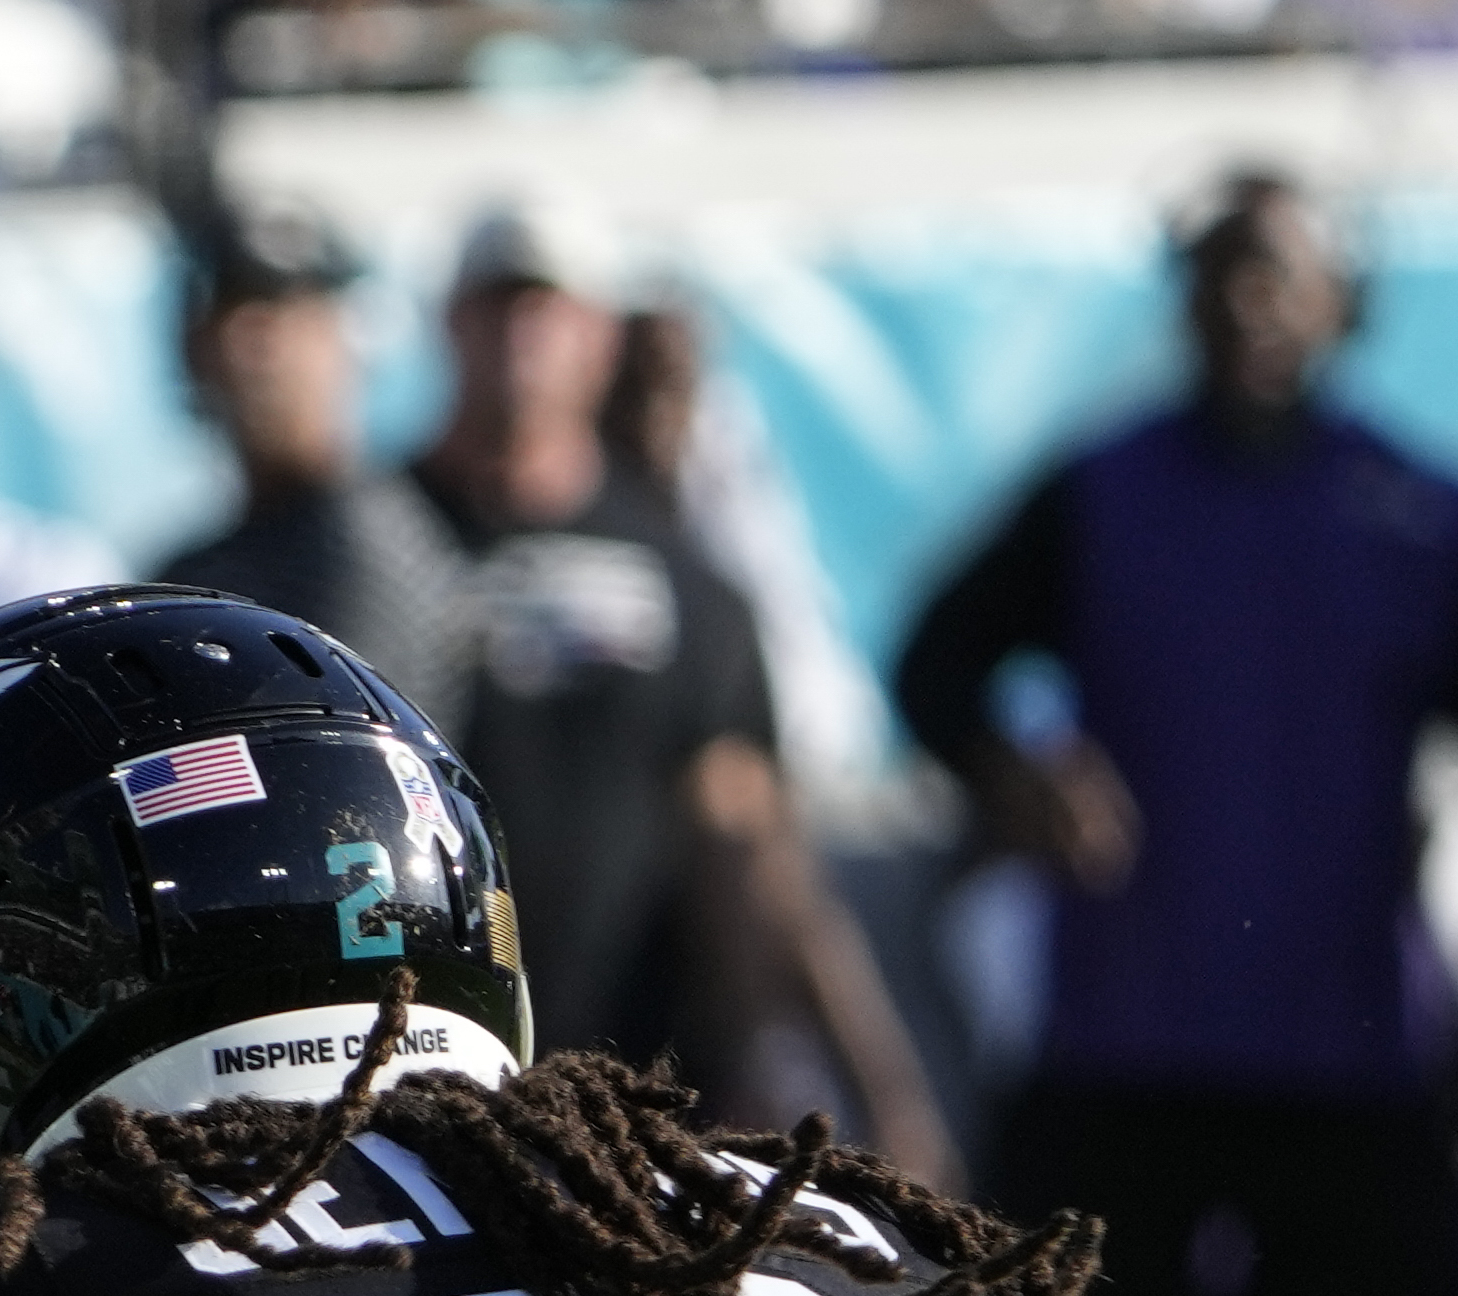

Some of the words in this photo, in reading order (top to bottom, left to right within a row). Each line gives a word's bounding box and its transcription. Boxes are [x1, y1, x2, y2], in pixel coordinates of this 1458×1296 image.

[326, 841, 405, 960] 2
[213, 1037, 335, 1075] INSPIRE
[343, 1028, 449, 1060] CNGE
